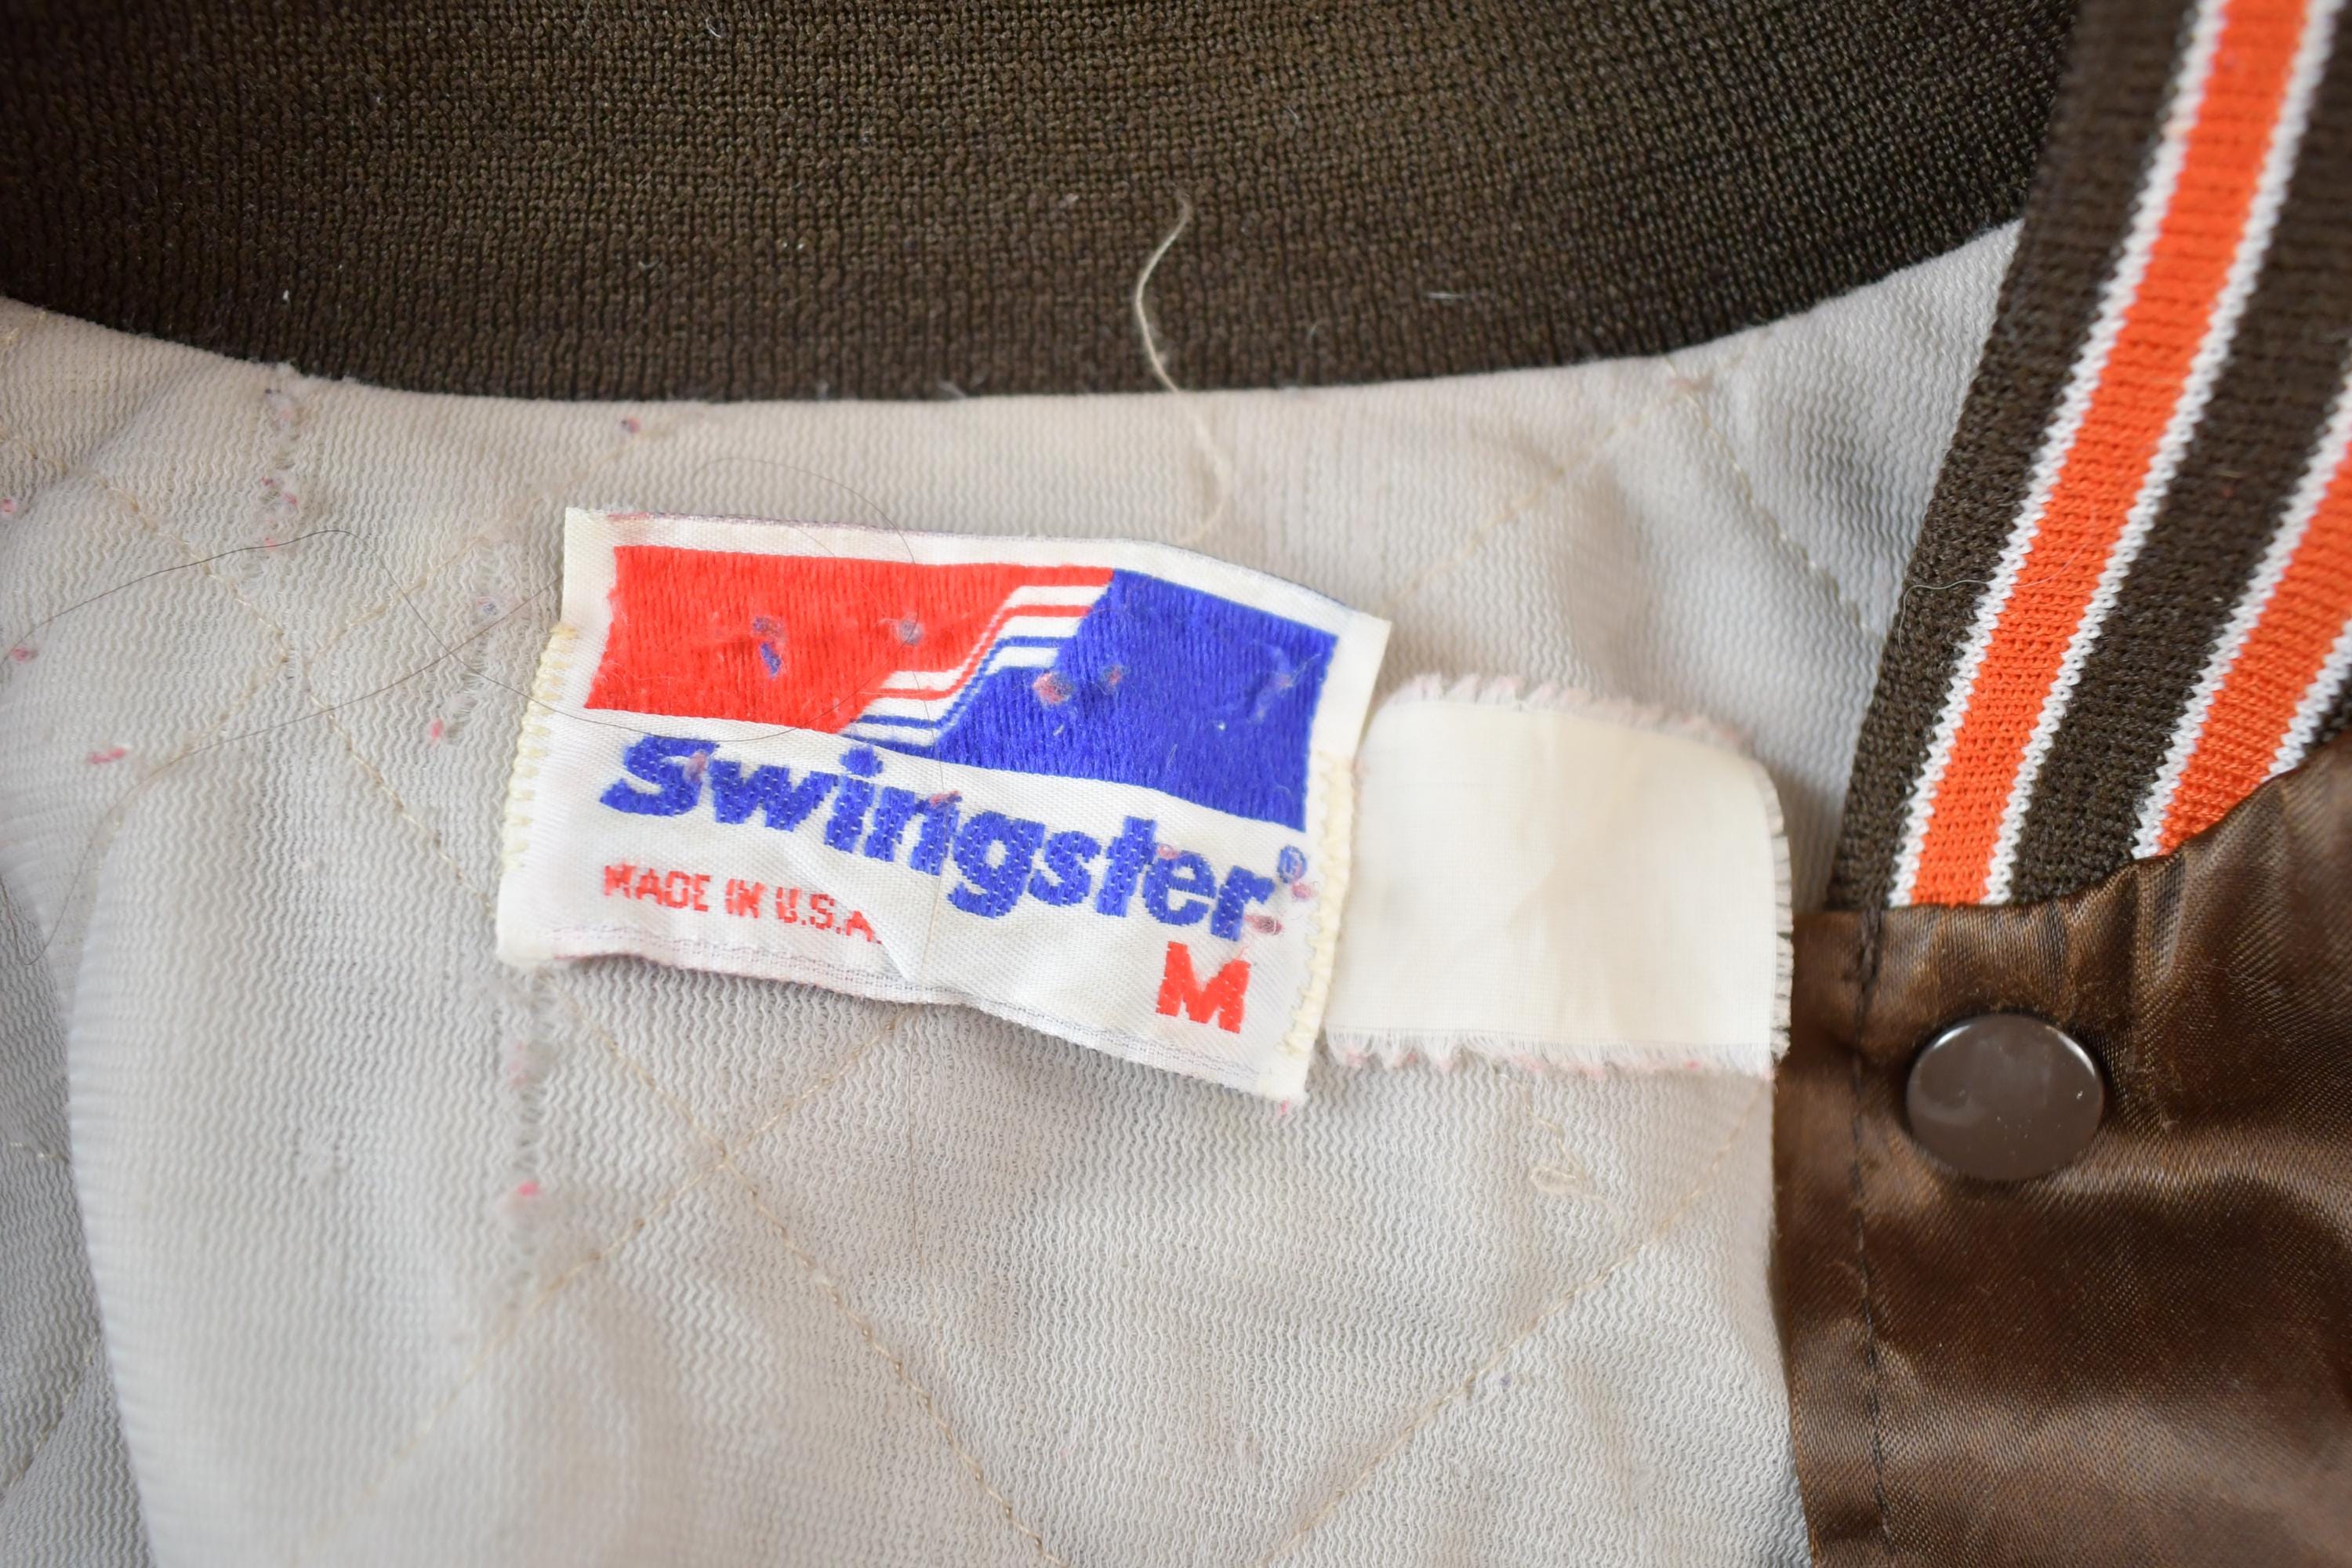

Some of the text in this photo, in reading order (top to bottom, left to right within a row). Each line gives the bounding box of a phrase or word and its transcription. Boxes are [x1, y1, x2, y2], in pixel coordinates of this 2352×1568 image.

[604, 864, 711, 913] MADE
[724, 877, 765, 918] IN
[1155, 940, 1252, 1034] M
